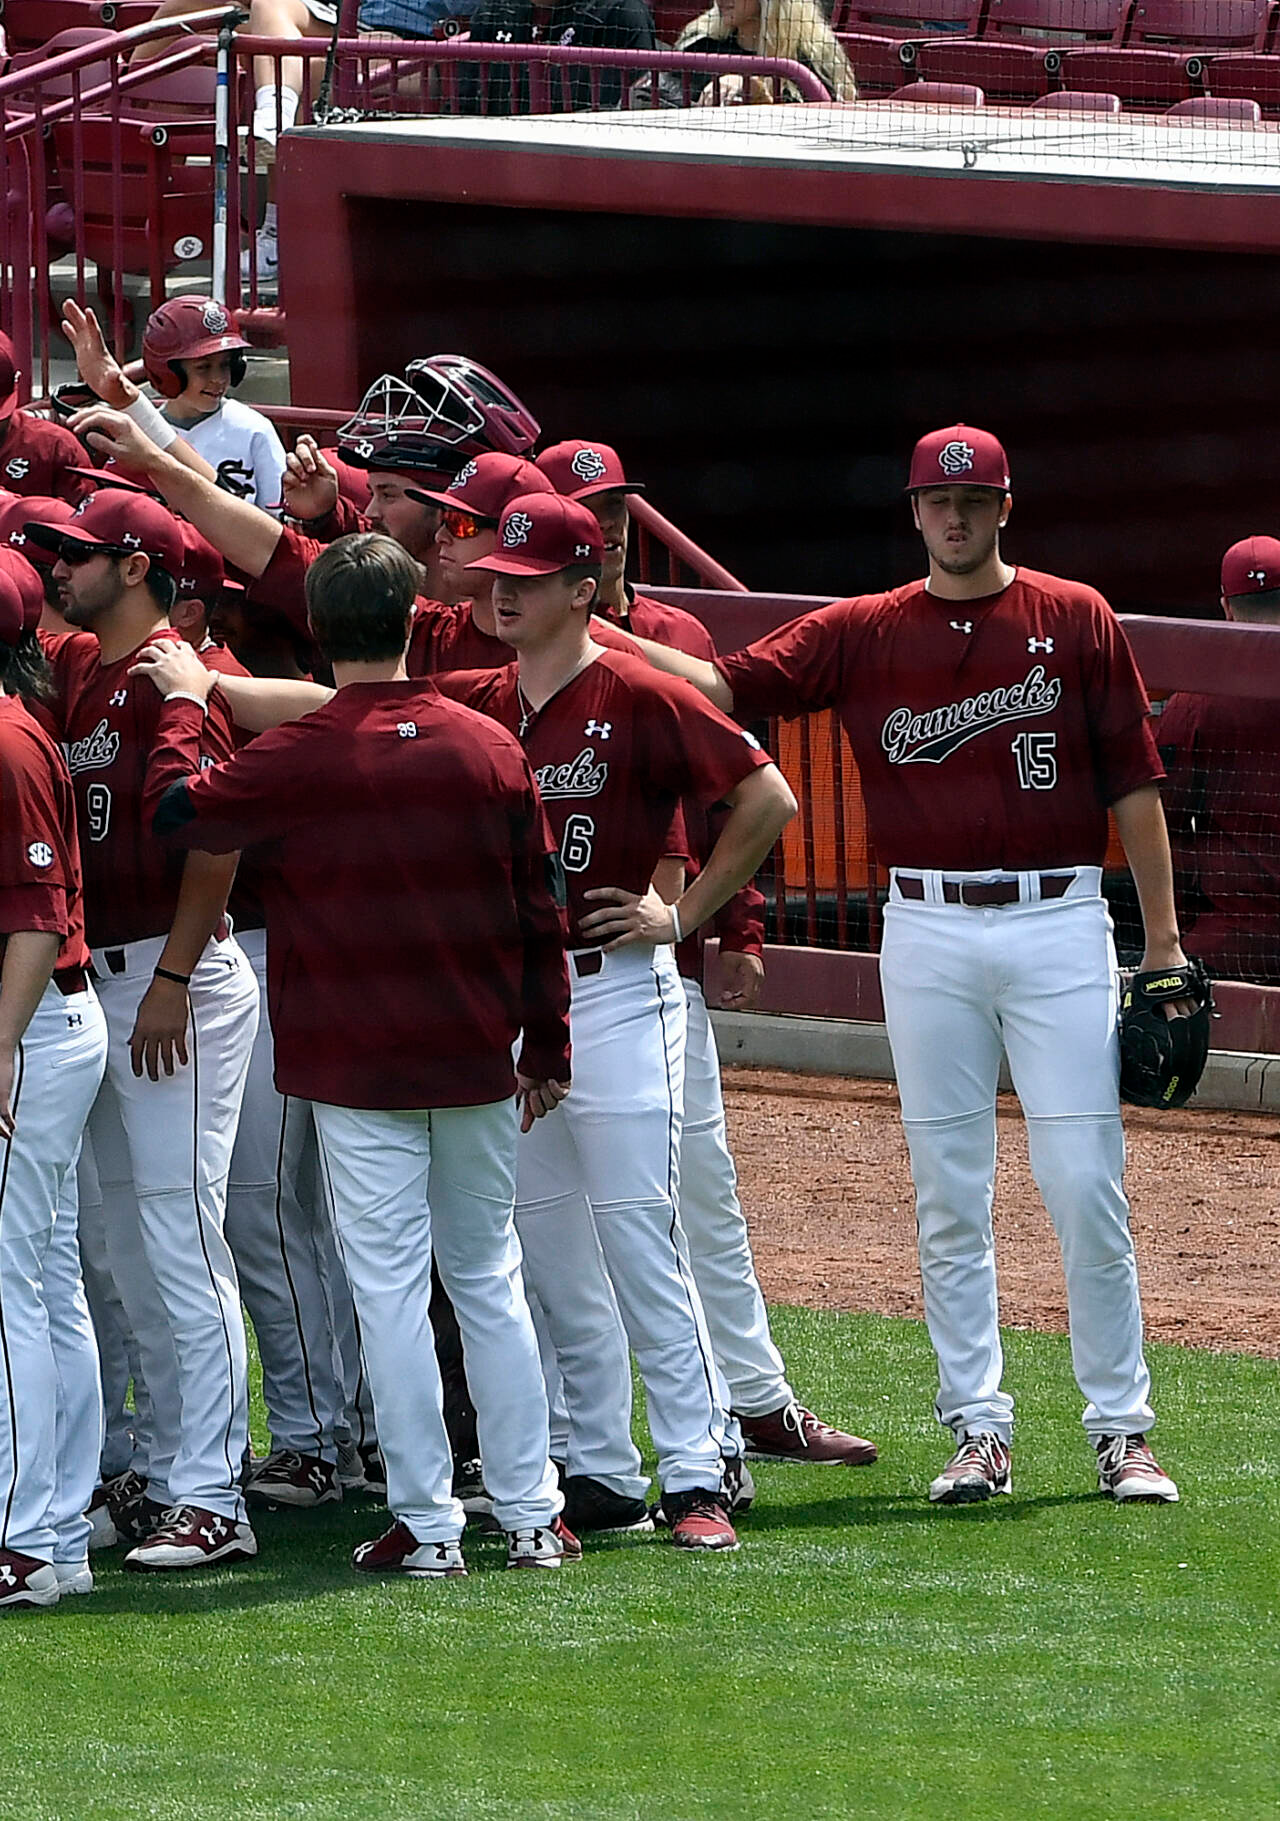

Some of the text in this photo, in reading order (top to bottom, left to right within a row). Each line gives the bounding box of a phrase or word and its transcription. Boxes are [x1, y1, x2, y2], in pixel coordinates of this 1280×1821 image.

[881, 665, 1062, 763] Gamecocks
[1011, 732, 1057, 790] 15
[87, 783, 112, 842] 9
[28, 841, 54, 867] SEC
[560, 813, 595, 873] 6
